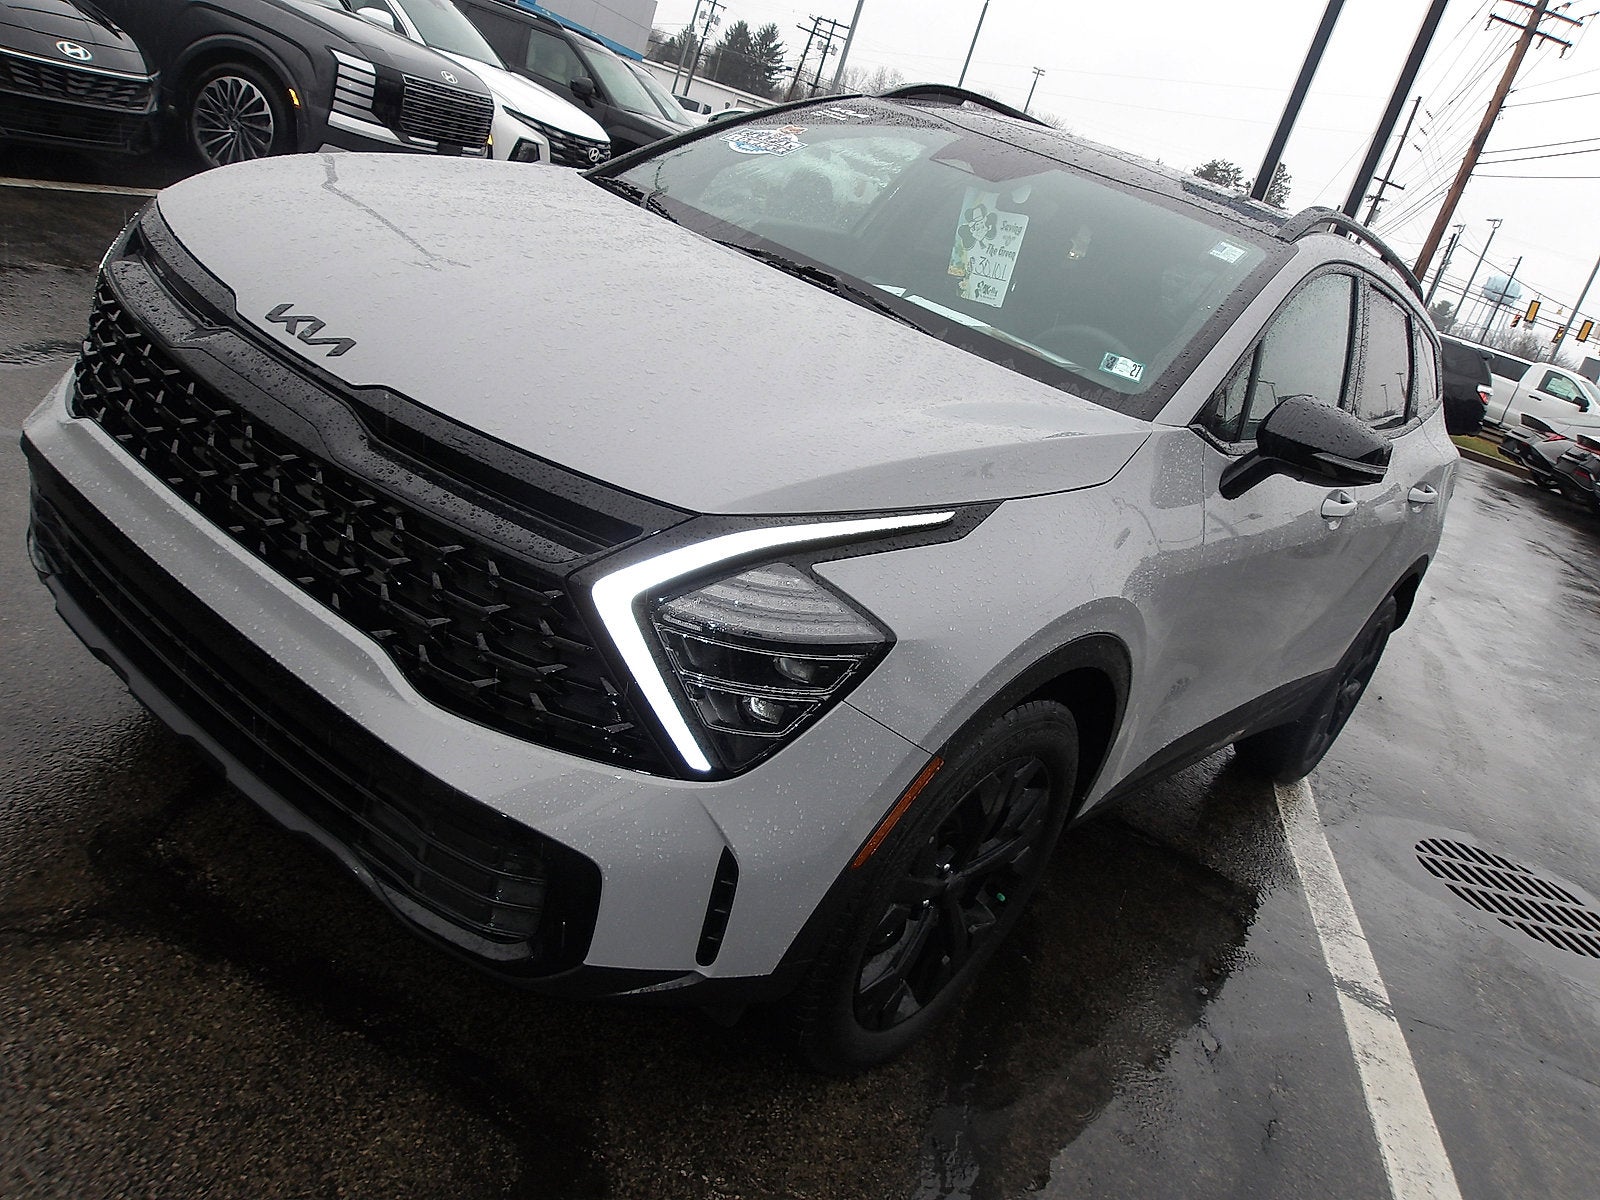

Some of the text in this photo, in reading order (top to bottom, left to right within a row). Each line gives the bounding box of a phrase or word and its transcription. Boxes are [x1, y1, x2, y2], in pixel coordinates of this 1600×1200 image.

[986, 243, 1017, 261] The Green
[264, 303, 357, 357] KIA
[1129, 363, 1142, 378] 27
